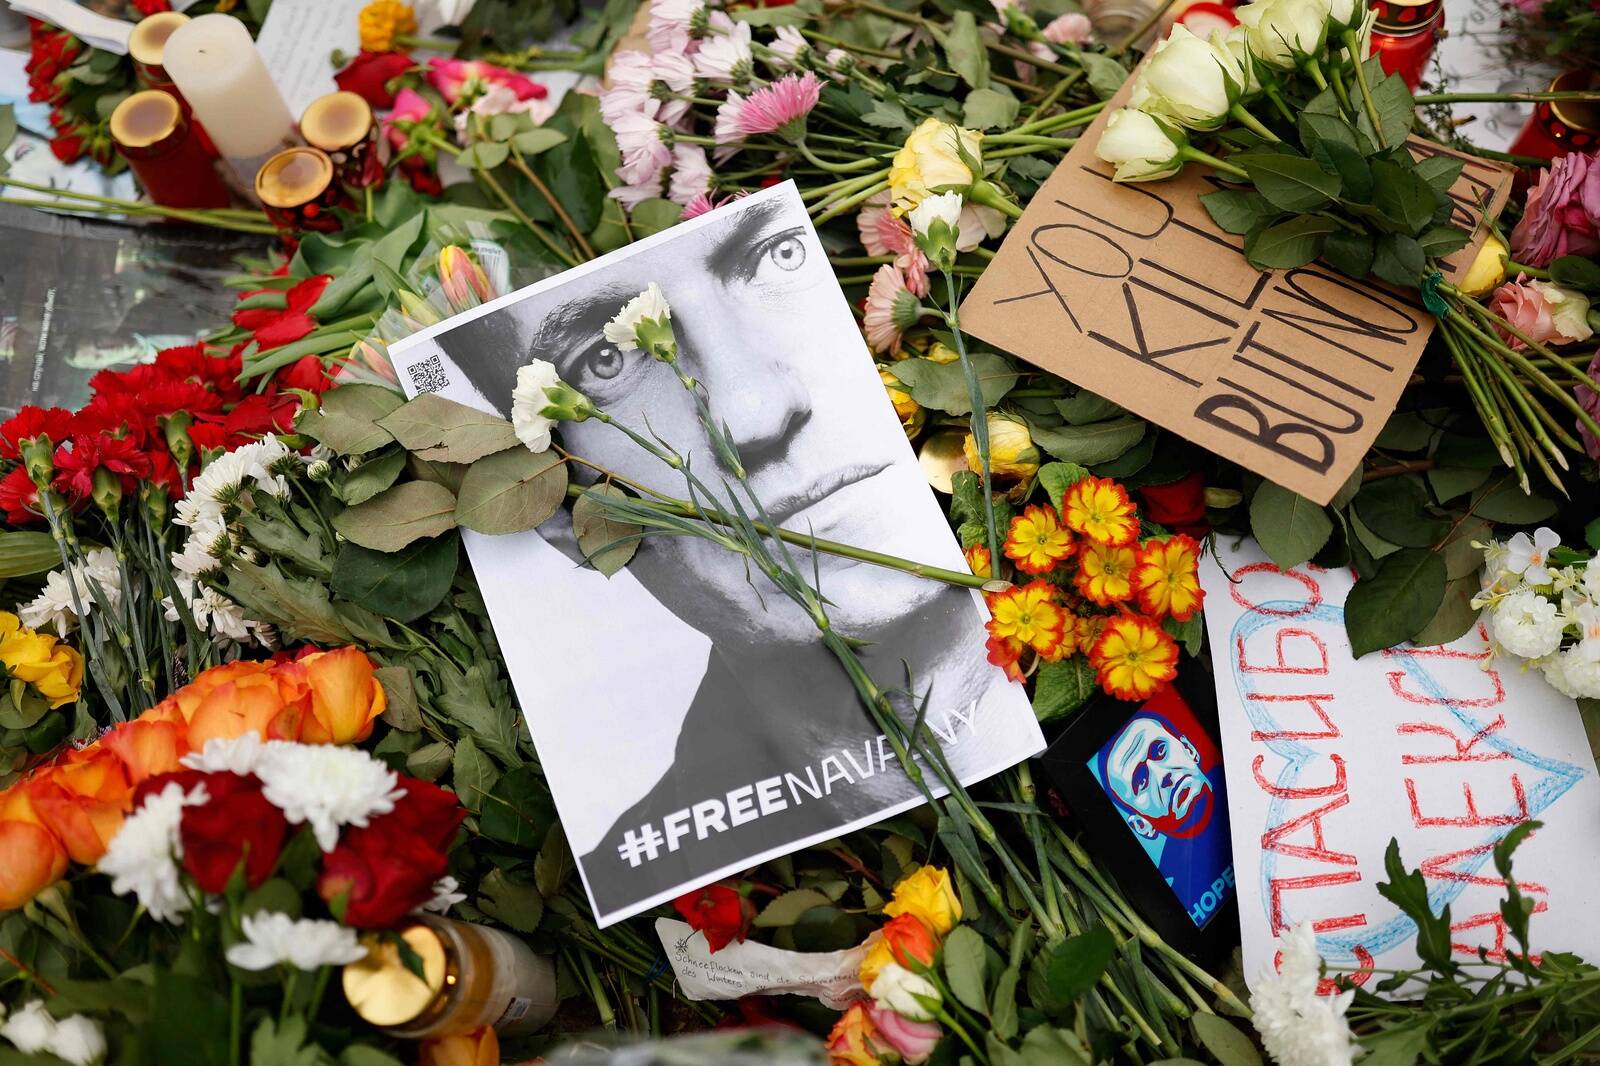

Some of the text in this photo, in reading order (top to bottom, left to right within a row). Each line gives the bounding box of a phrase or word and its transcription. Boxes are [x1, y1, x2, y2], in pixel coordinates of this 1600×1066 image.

[993, 166, 1173, 333] YOU
[617, 700, 979, 868] #FREENAVANY
[675, 951, 743, 975] Schneeflocken
[682, 966, 697, 978] des
